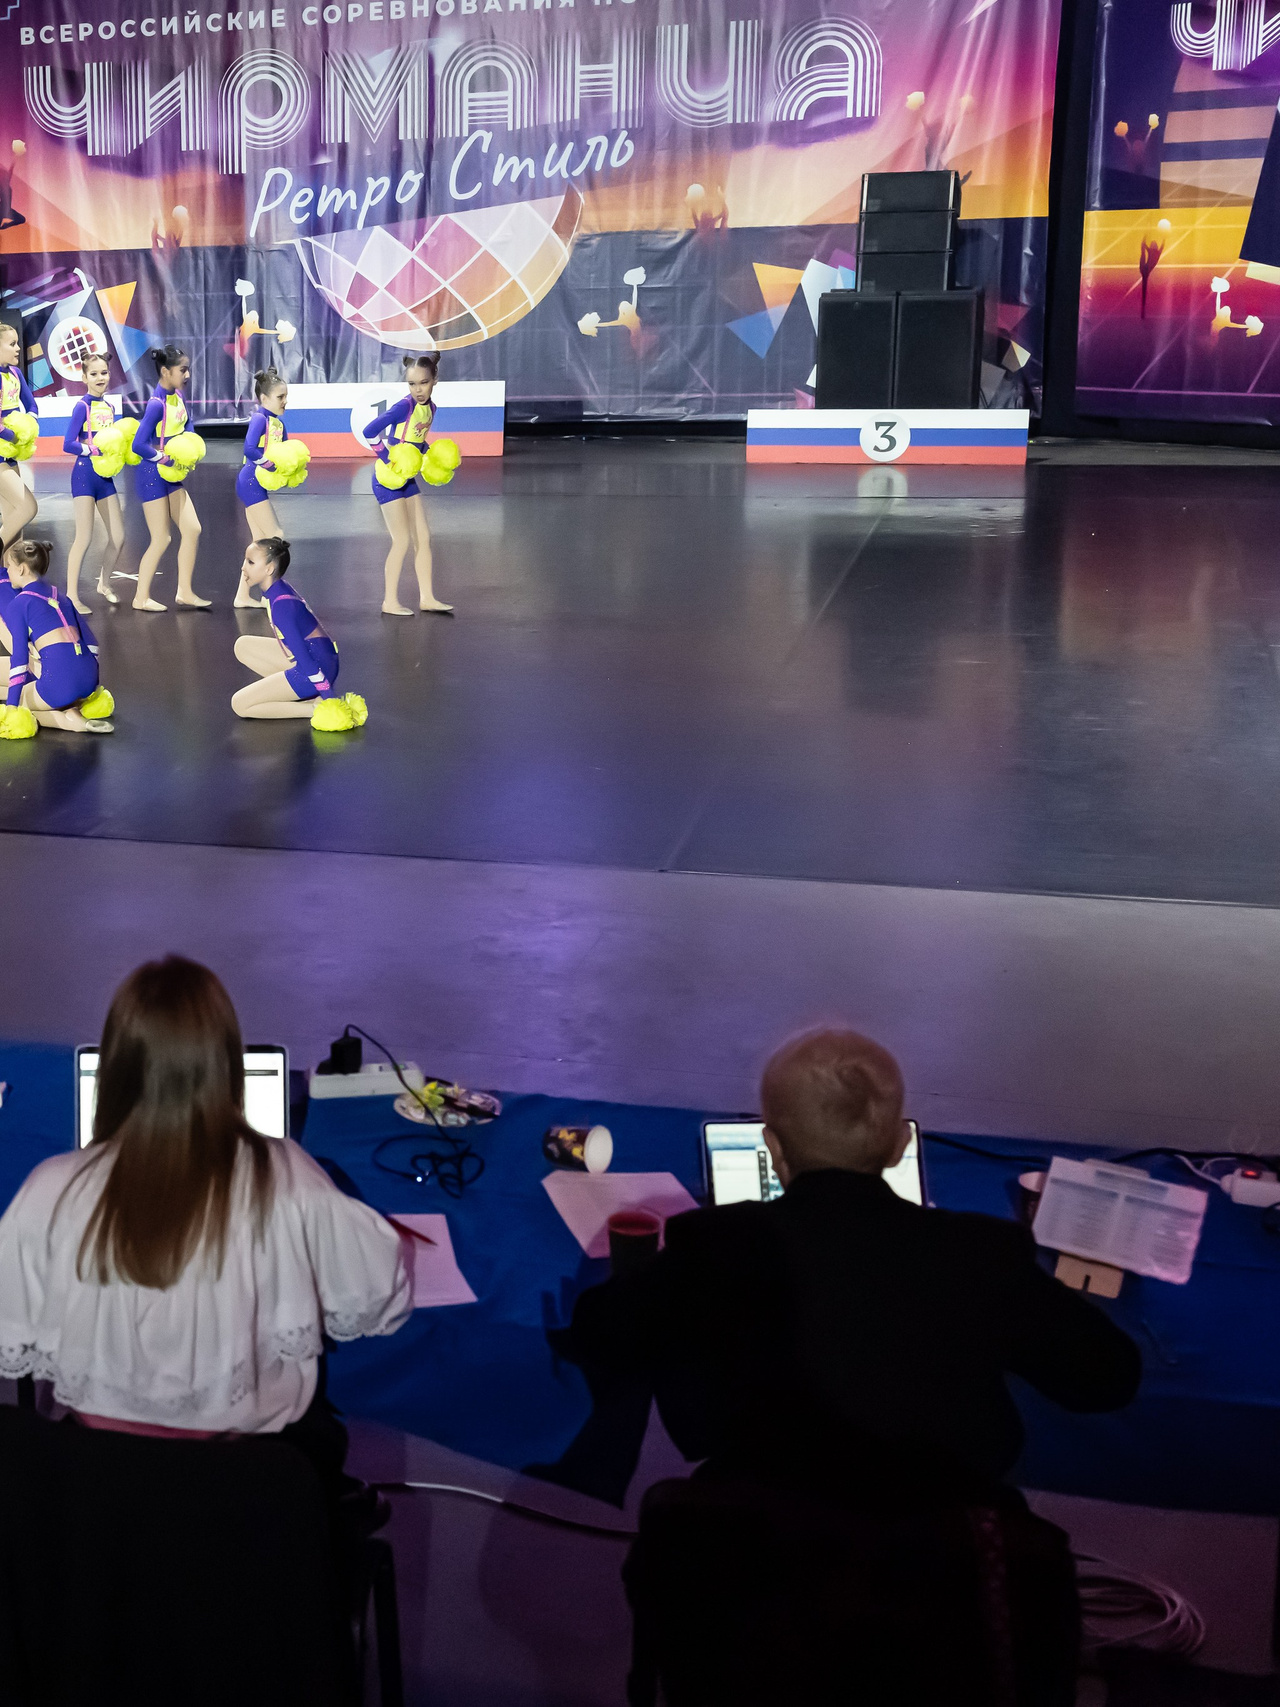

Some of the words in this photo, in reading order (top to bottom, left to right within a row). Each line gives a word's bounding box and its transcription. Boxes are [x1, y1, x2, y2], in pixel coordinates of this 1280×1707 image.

[20, 9, 286, 45] ВСЕРОССИЙСКИЕ
[249, 166, 424, 237] Ретро
[449, 129, 634, 200] Стиль
[873, 422, 897, 453] 3
